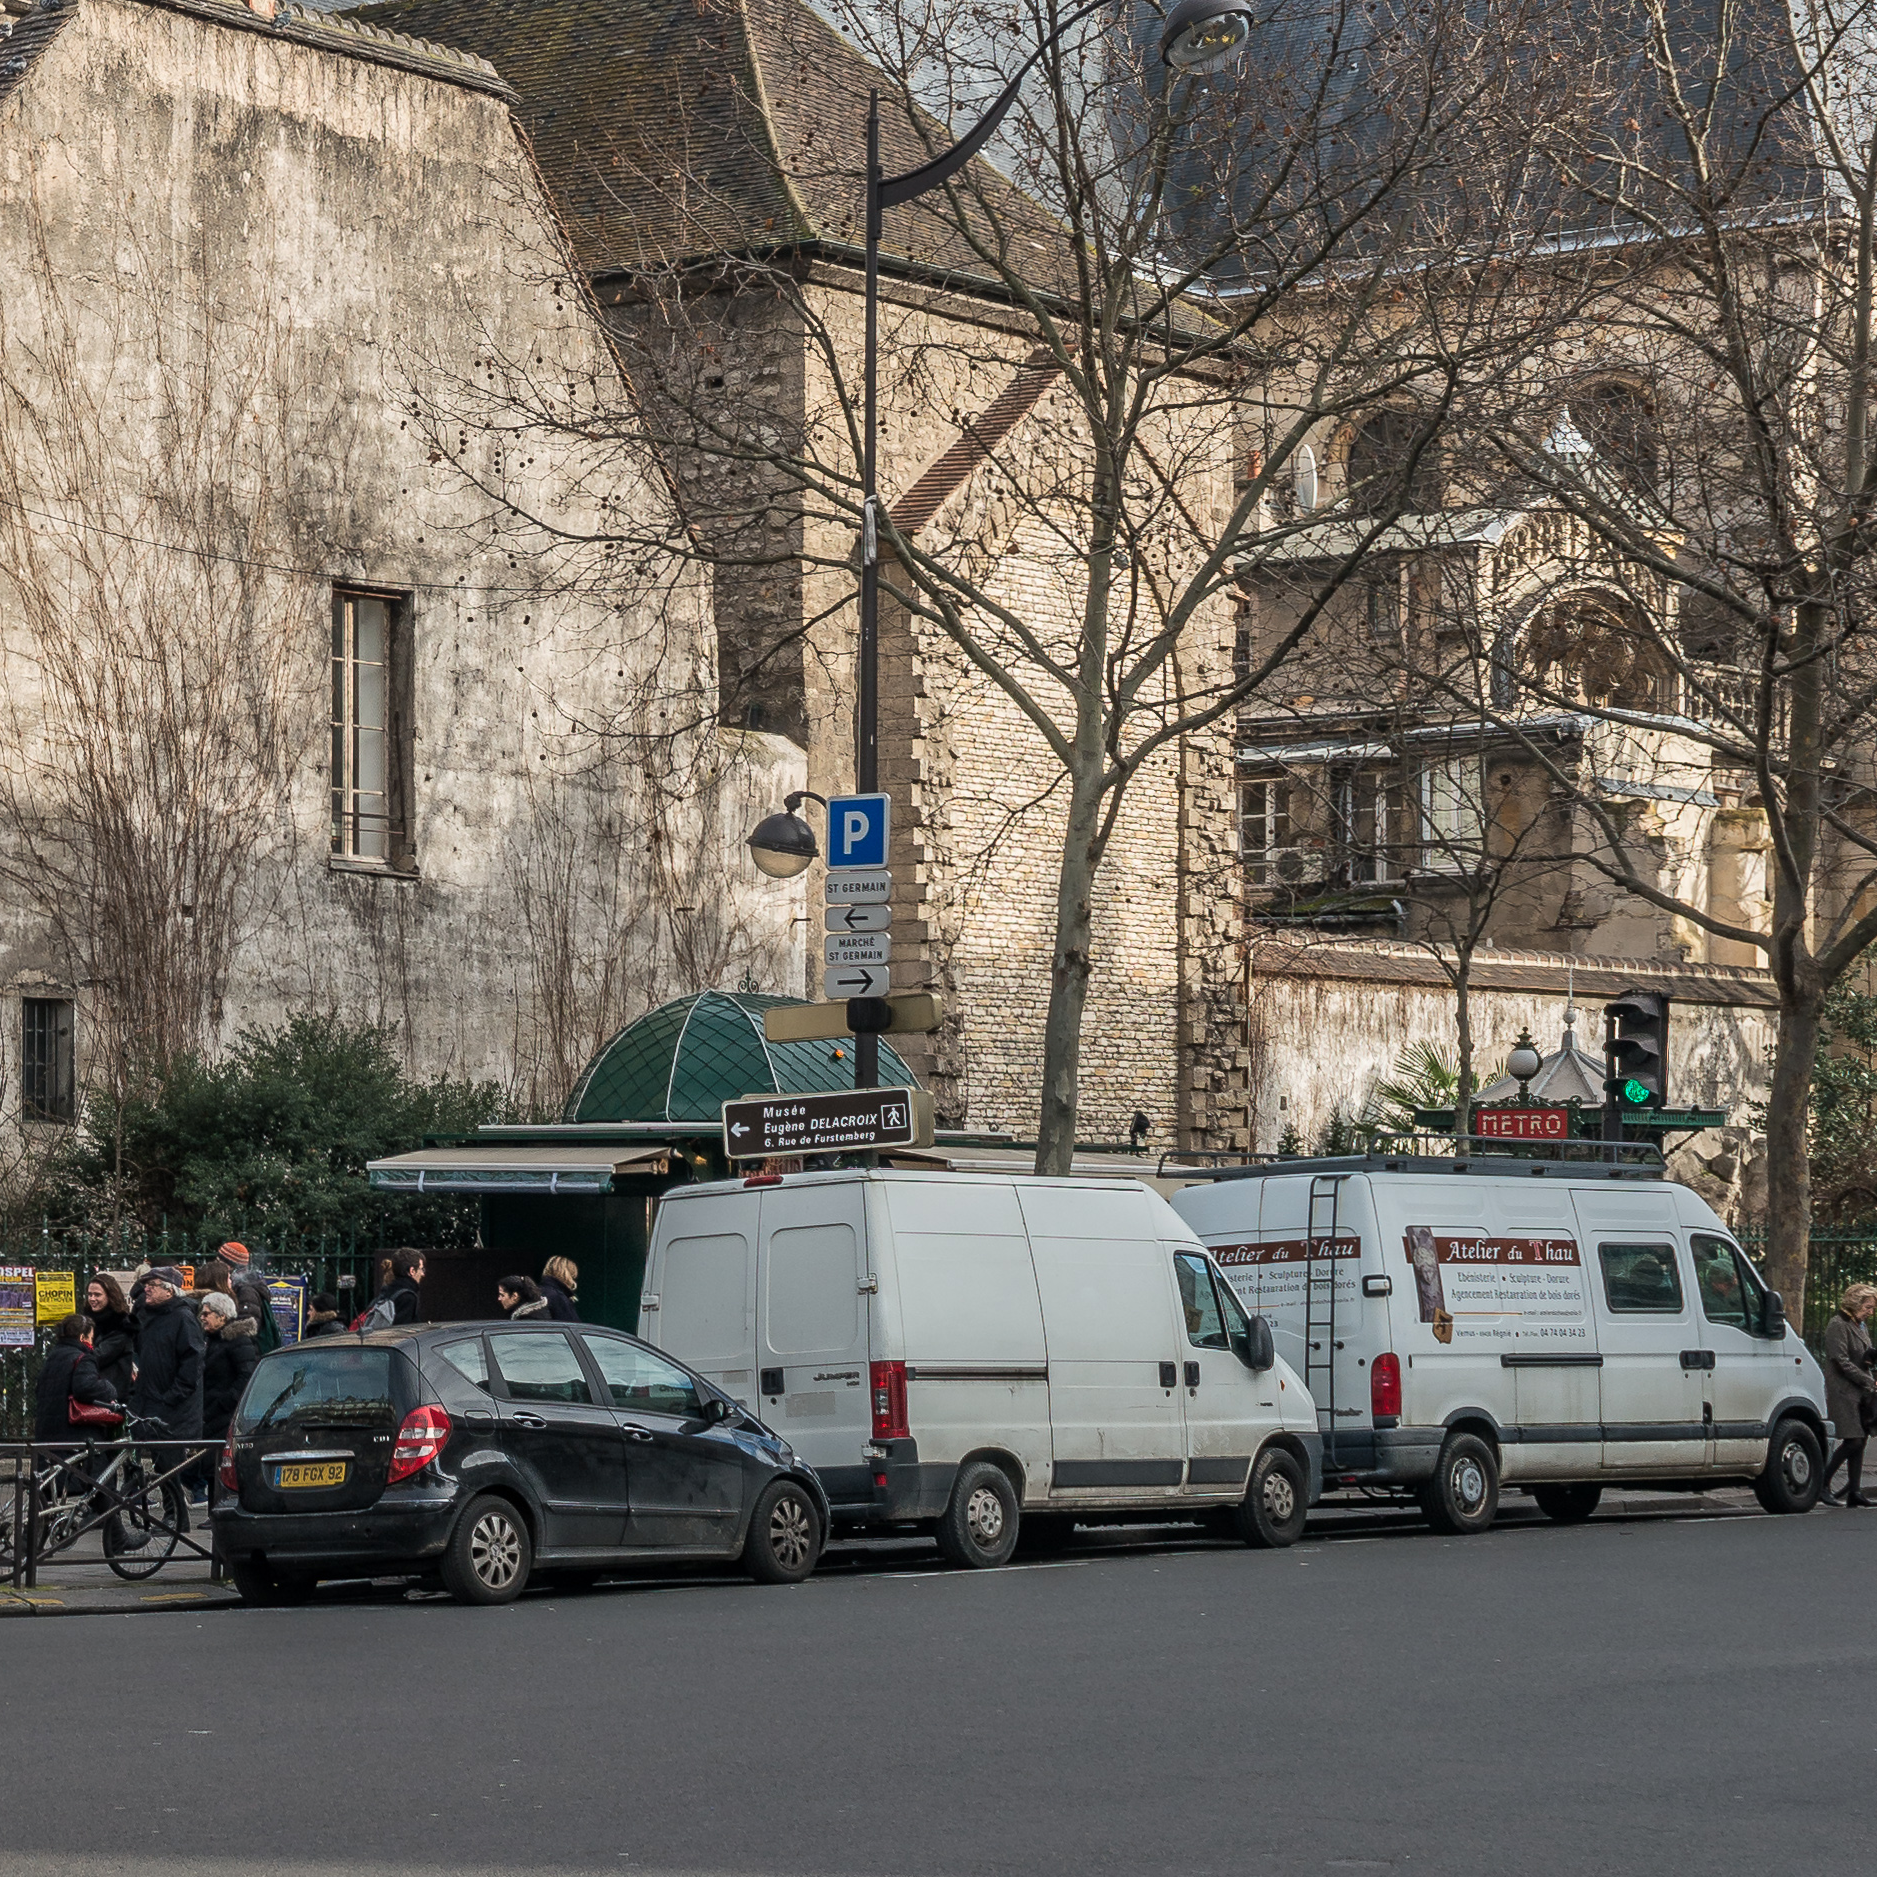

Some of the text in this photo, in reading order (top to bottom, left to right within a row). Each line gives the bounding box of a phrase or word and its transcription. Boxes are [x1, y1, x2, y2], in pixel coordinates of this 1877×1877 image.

[843, 811, 870, 855] P
[827, 881, 886, 894] ST GERMAIN
[838, 936, 875, 948] MARCHÉ
[828, 949, 883, 961] ST GERMAIN
[763, 1105, 806, 1118] Musée
[764, 1113, 878, 1135] Eugène DELACROIX
[1483, 1114, 1561, 1135] METRO
[778, 1137, 796, 1146] Rue
[800, 1135, 812, 1145] de
[1272, 1247, 1289, 1260] du
[1446, 1240, 1573, 1261] Atelier du Thau
[1509, 1273, 1541, 1286] Sculpture
[38, 1290, 73, 1298] CHOPIN
[1451, 1288, 1493, 1301] Agencement
[282, 1465, 343, 1482] 178 FGX 92
